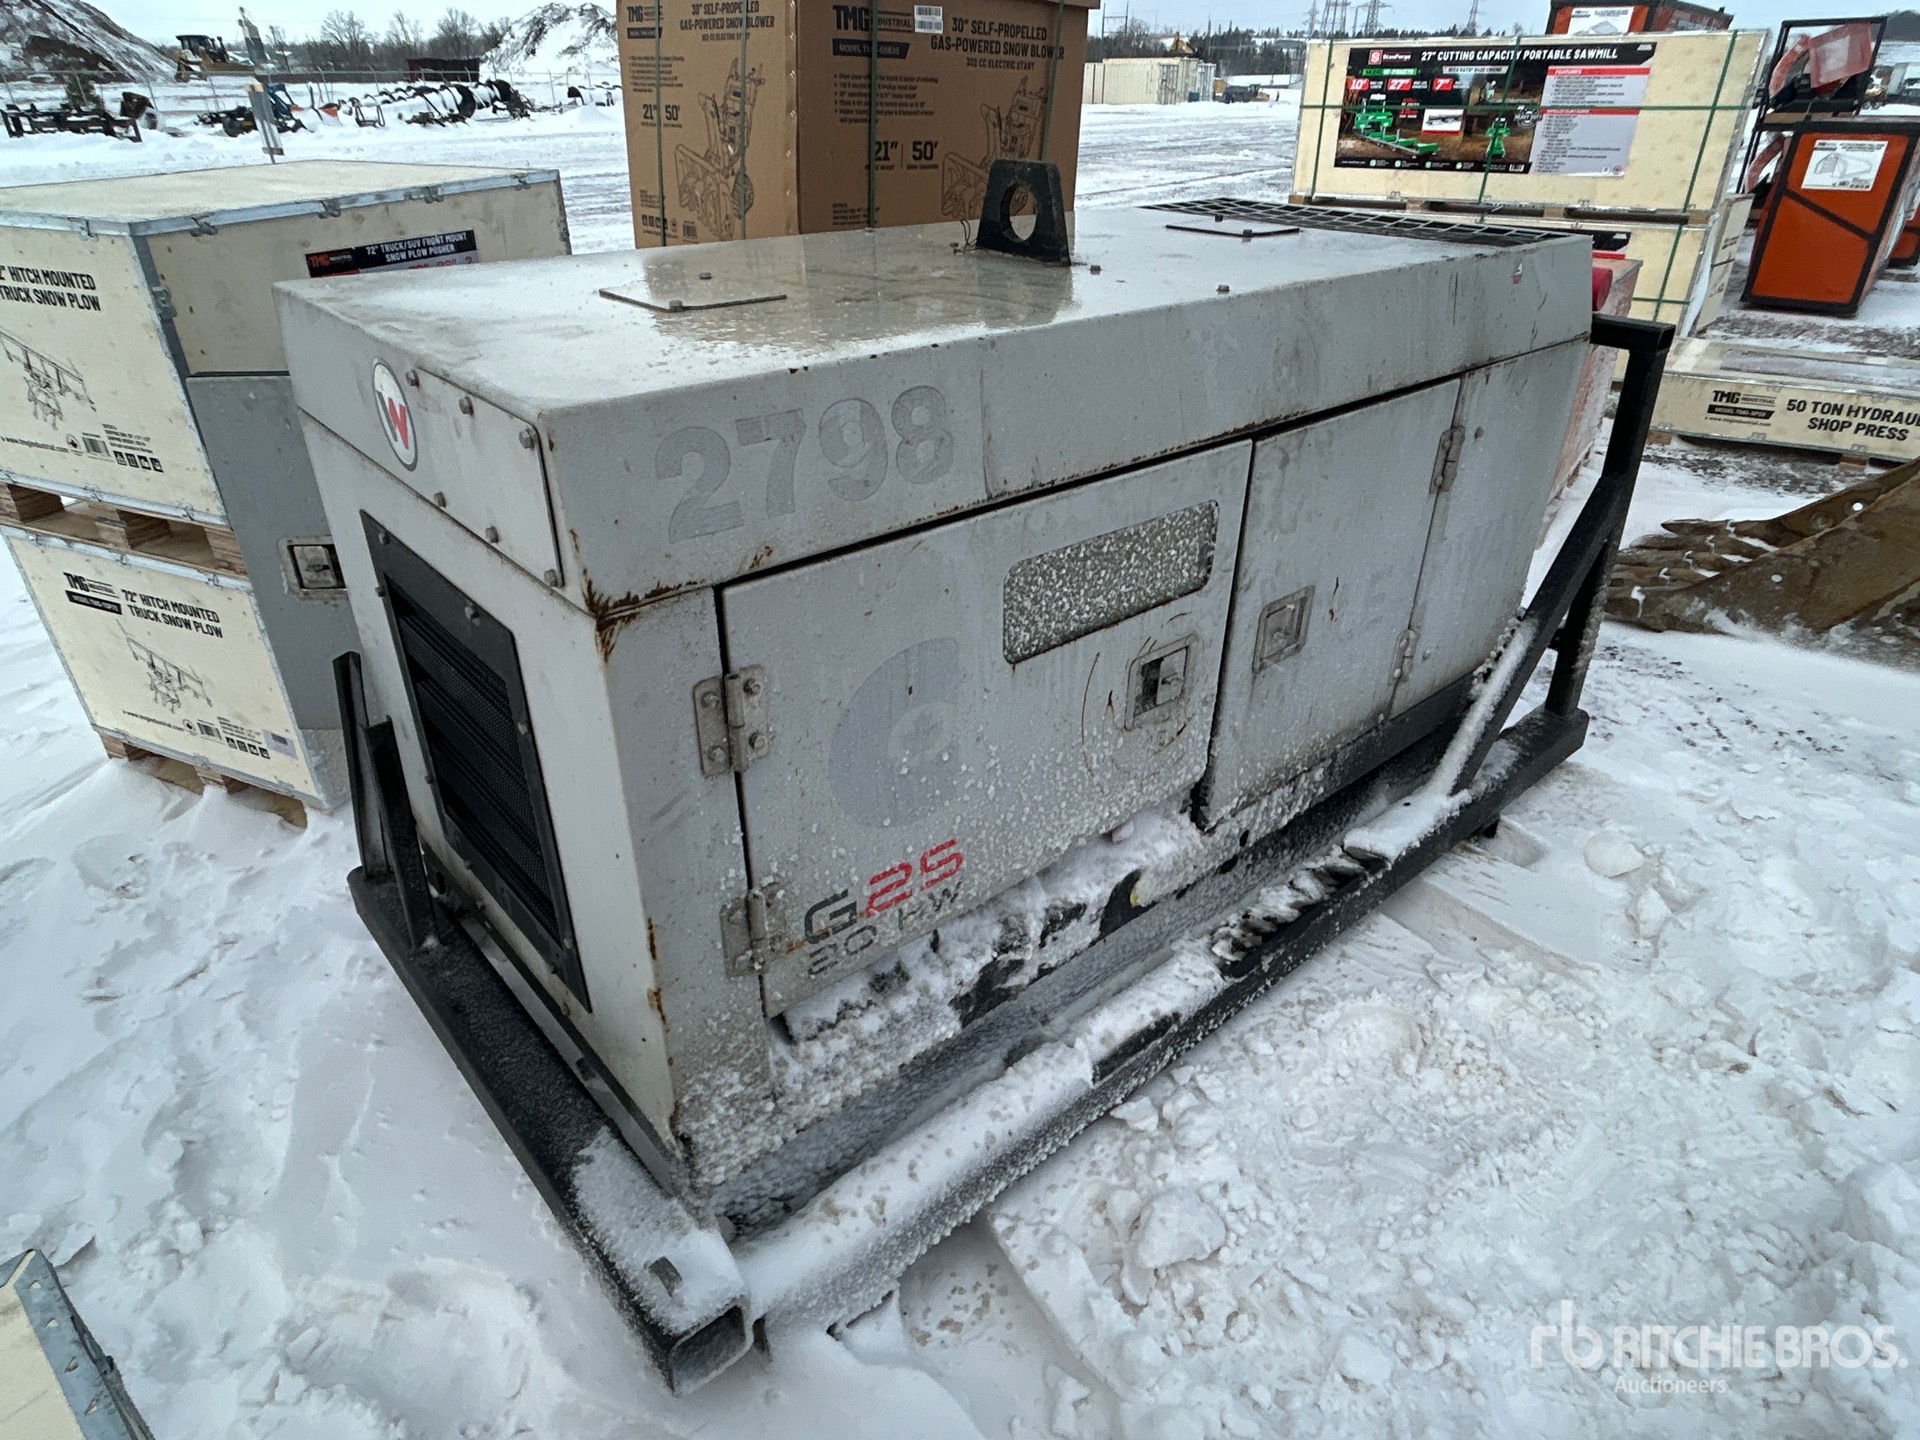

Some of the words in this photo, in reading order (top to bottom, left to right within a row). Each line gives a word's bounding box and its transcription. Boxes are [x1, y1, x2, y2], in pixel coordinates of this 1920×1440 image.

[627, 6, 644, 22] TMG
[704, 1, 760, 15] SELF-PROPELED
[832, 5, 870, 31] TMG
[680, 18, 724, 30] GAS-POWERED
[951, 17, 969, 33] 30"
[970, 21, 1047, 41] SELF-PROPELLED
[930, 34, 1001, 54] GAS-POWERED
[1002, 40, 1029, 57] SNOW
[1030, 43, 1064, 61] BLOWR
[1421, 51, 1436, 62] 27"
[1437, 50, 1475, 61] CUTTING
[1477, 49, 1521, 60] CAPACITY
[1523, 49, 1571, 60] PORTABLE
[1574, 49, 1618, 60] SAWMILL
[988, 59, 1015, 70] ELECTRIC
[1016, 60, 1035, 71] START
[1389, 79, 1411, 90] 27"
[1437, 79, 1452, 90] 7"
[665, 104, 680, 121] 50'
[875, 141, 898, 161] 21"
[912, 141, 938, 161] 50'
[365, 245, 379, 256] 72"
[380, 239, 421, 254] TRUCK/SUV
[422, 235, 444, 247] FRONT
[445, 232, 467, 244] MOUNT
[386, 251, 407, 262] SNOW
[408, 248, 428, 259] PLOW
[429, 244, 455, 256] PUSHER
[8, 266, 43, 284] HITCH
[41, 270, 96, 291] MOUNTED
[0, 285, 34, 303] TRUCK
[33, 289, 67, 307] SNOW
[66, 293, 101, 311] PLOW
[1712, 390, 1741, 404] TMG
[1786, 399, 1807, 412] 50
[1811, 401, 1844, 416] TON
[1808, 417, 1852, 433] SHOP
[1854, 422, 1909, 442] PRESS
[655, 385, 954, 544] 2798
[63, 572, 90, 592] TMG
[121, 589, 138, 602] 72"
[140, 594, 170, 611] HITCH
[172, 602, 220, 623] MOUNTED
[127, 604, 162, 623] TRUCK
[161, 613, 192, 631] SNOW
[194, 621, 223, 639] PLOW
